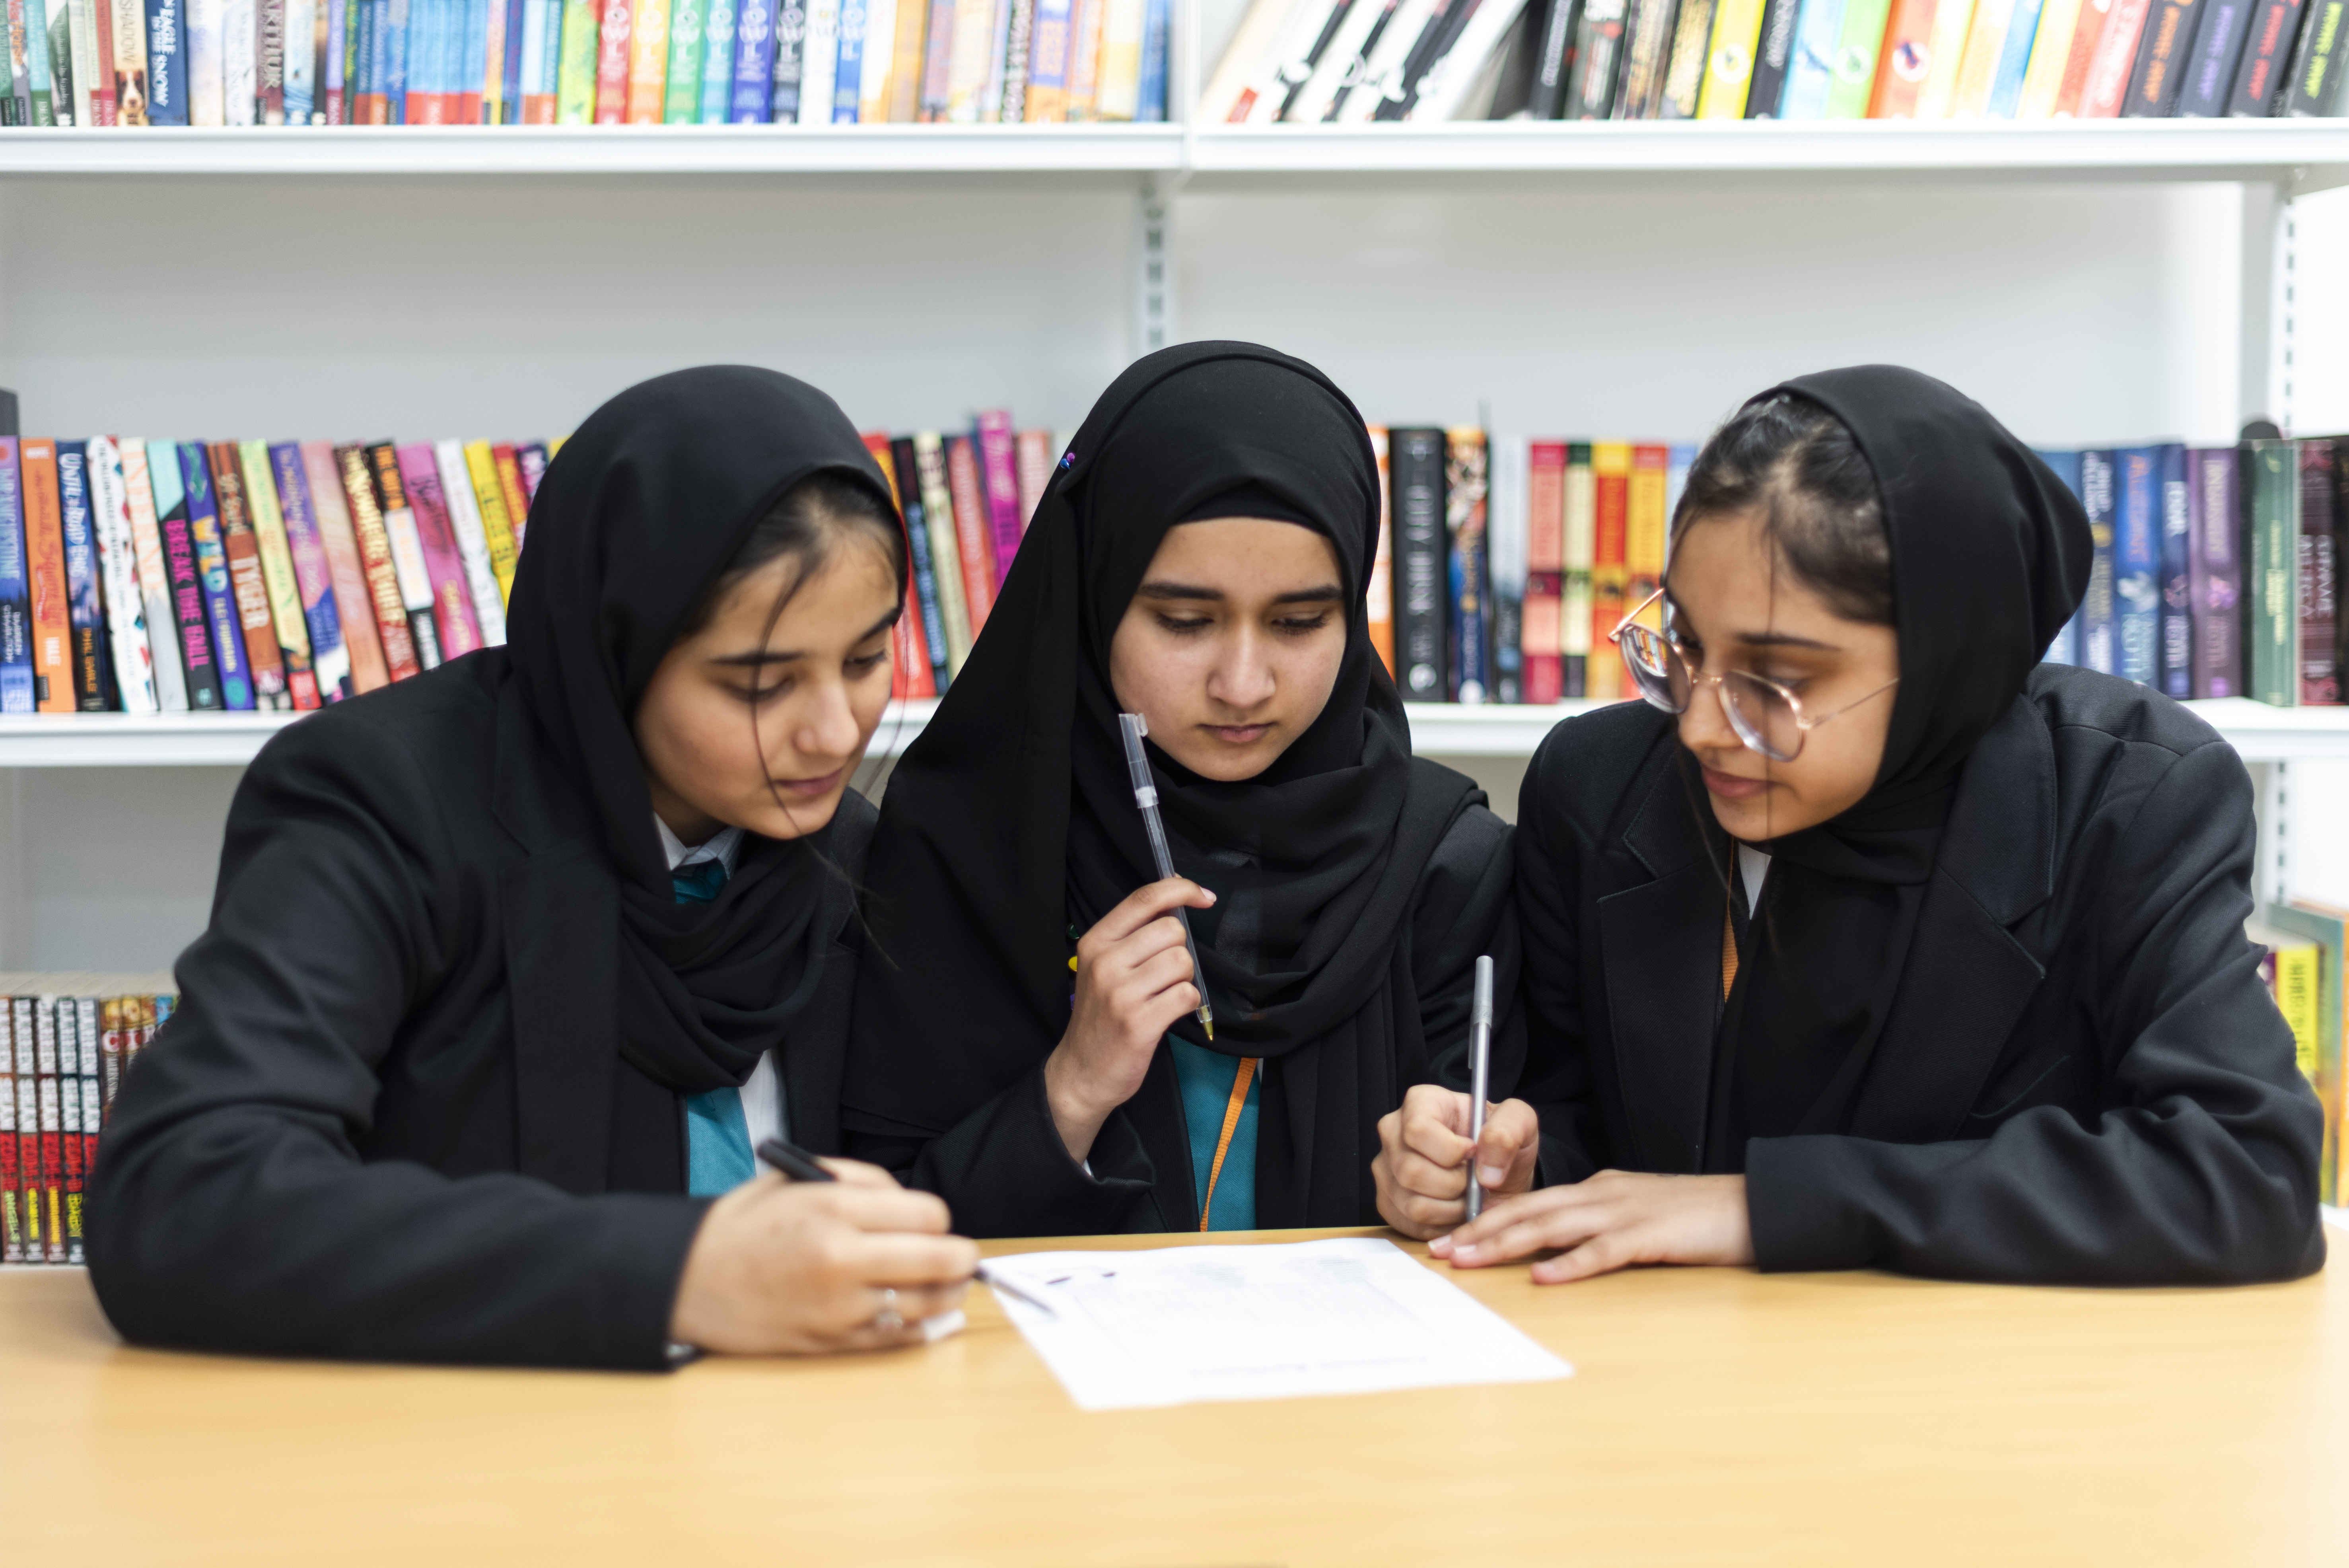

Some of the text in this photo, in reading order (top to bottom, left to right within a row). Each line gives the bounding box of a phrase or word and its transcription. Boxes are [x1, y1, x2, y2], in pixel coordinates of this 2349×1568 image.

[10, 21, 25, 65] Horse
[151, 31, 162, 54] THE
[159, 8, 177, 55] EAGLE
[151, 55, 169, 107] SNOW
[58, 453, 85, 498] UNTIL
[65, 507, 90, 545] ROAD
[122, 450, 165, 591] INFERNO
[68, 545, 90, 578] ENDS
[165, 519, 194, 584] BREAK
[191, 515, 228, 593] WILD
[177, 586, 202, 623] THE
[229, 554, 269, 631] TYGER
[183, 624, 210, 672] FALL
[0, 999, 13, 1074] DARREN
[14, 999, 33, 1074] DARREN
[58, 1000, 77, 1074] DARREN
[80, 1000, 98, 1075] DARREN
[0, 1078, 16, 1131] SHAN
[18, 1078, 38, 1132] SHAN
[40, 1078, 59, 1131] SHAN
[62, 1078, 81, 1131] SHAN
[82, 1078, 102, 1133] SHAN
[67, 1193, 84, 1239] BABY
